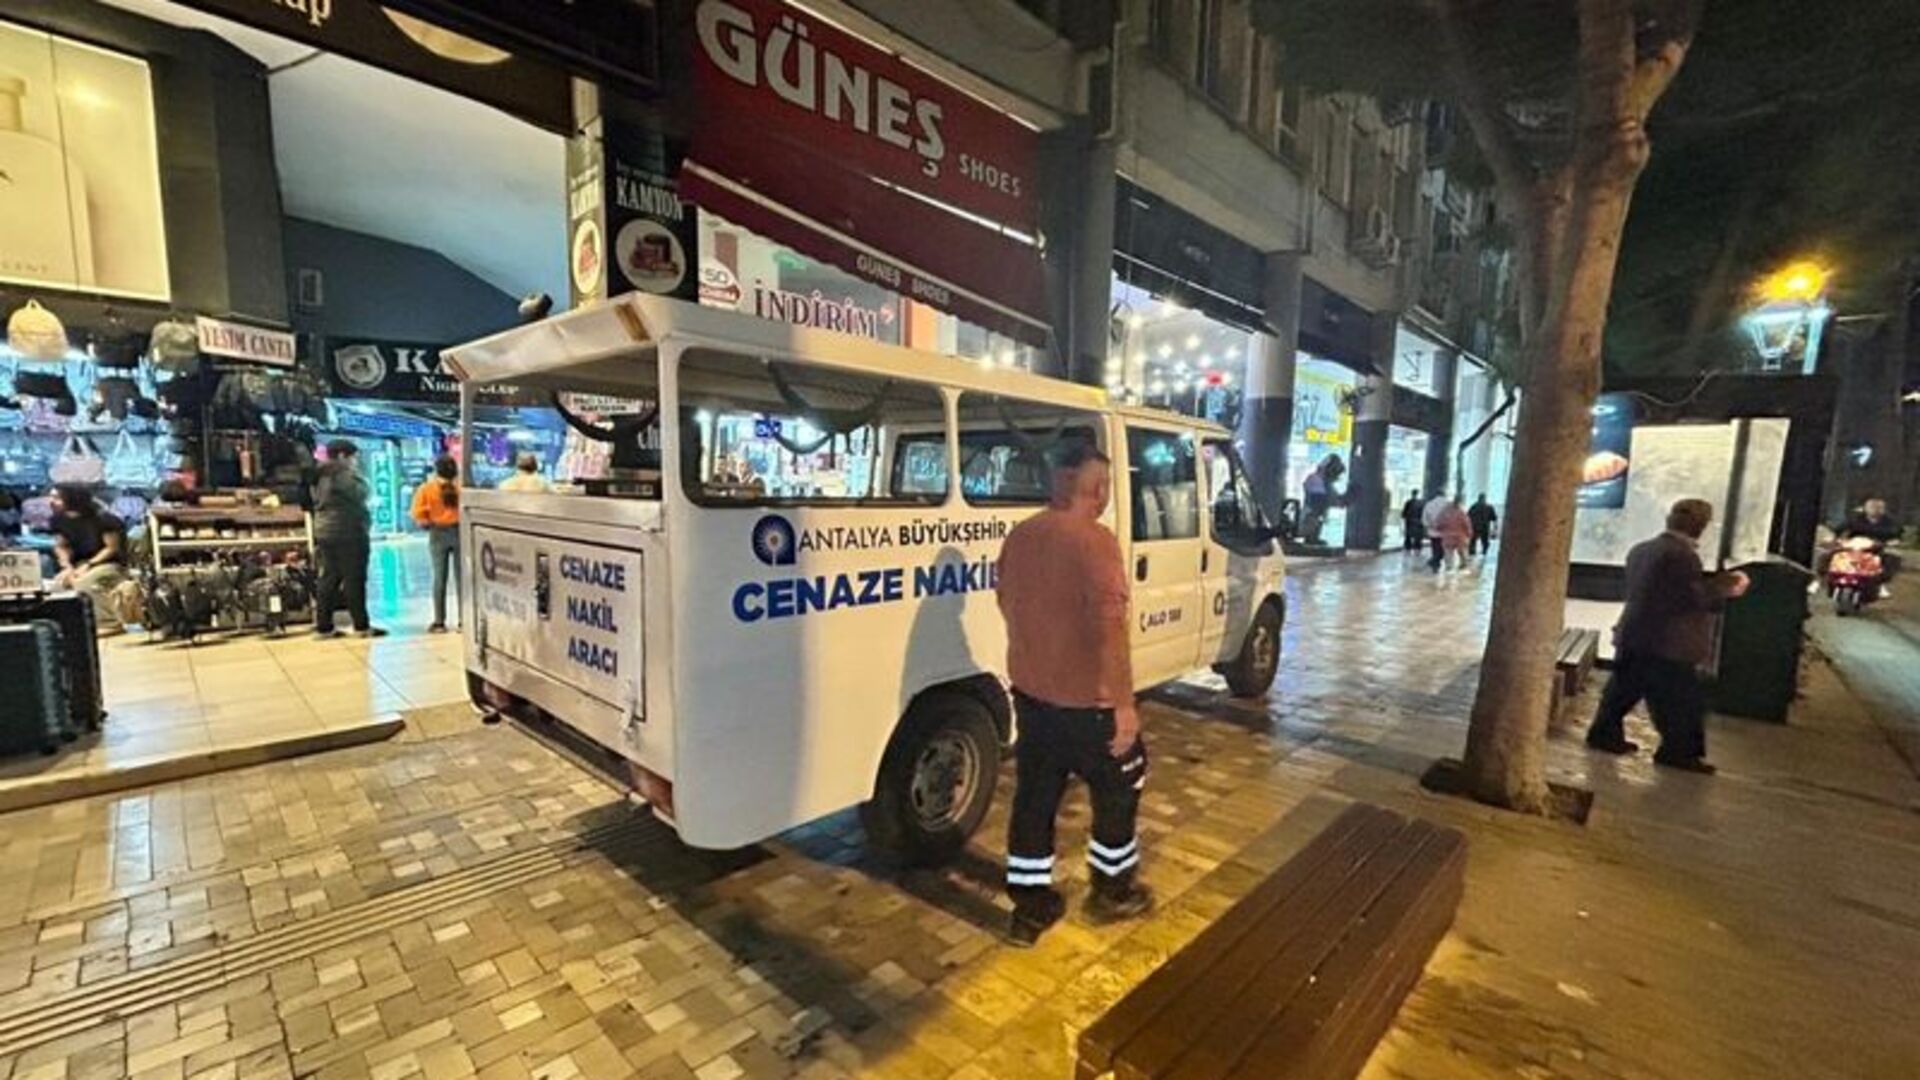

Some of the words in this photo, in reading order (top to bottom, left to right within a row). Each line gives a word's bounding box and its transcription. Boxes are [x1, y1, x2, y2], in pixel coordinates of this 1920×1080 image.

[695, 0, 945, 178] GÜNEŞ
[959, 152, 1022, 199] SHOES
[754, 279, 878, 339] İNDİRİM
[798, 526, 894, 552] ANTALYA
[899, 515, 1007, 547] BÜYÜKŞEHİR
[559, 554, 626, 592] CENAZE
[566, 595, 618, 634] NAKİL
[732, 568, 904, 623] CENAZE
[567, 636, 618, 677] ARACI
